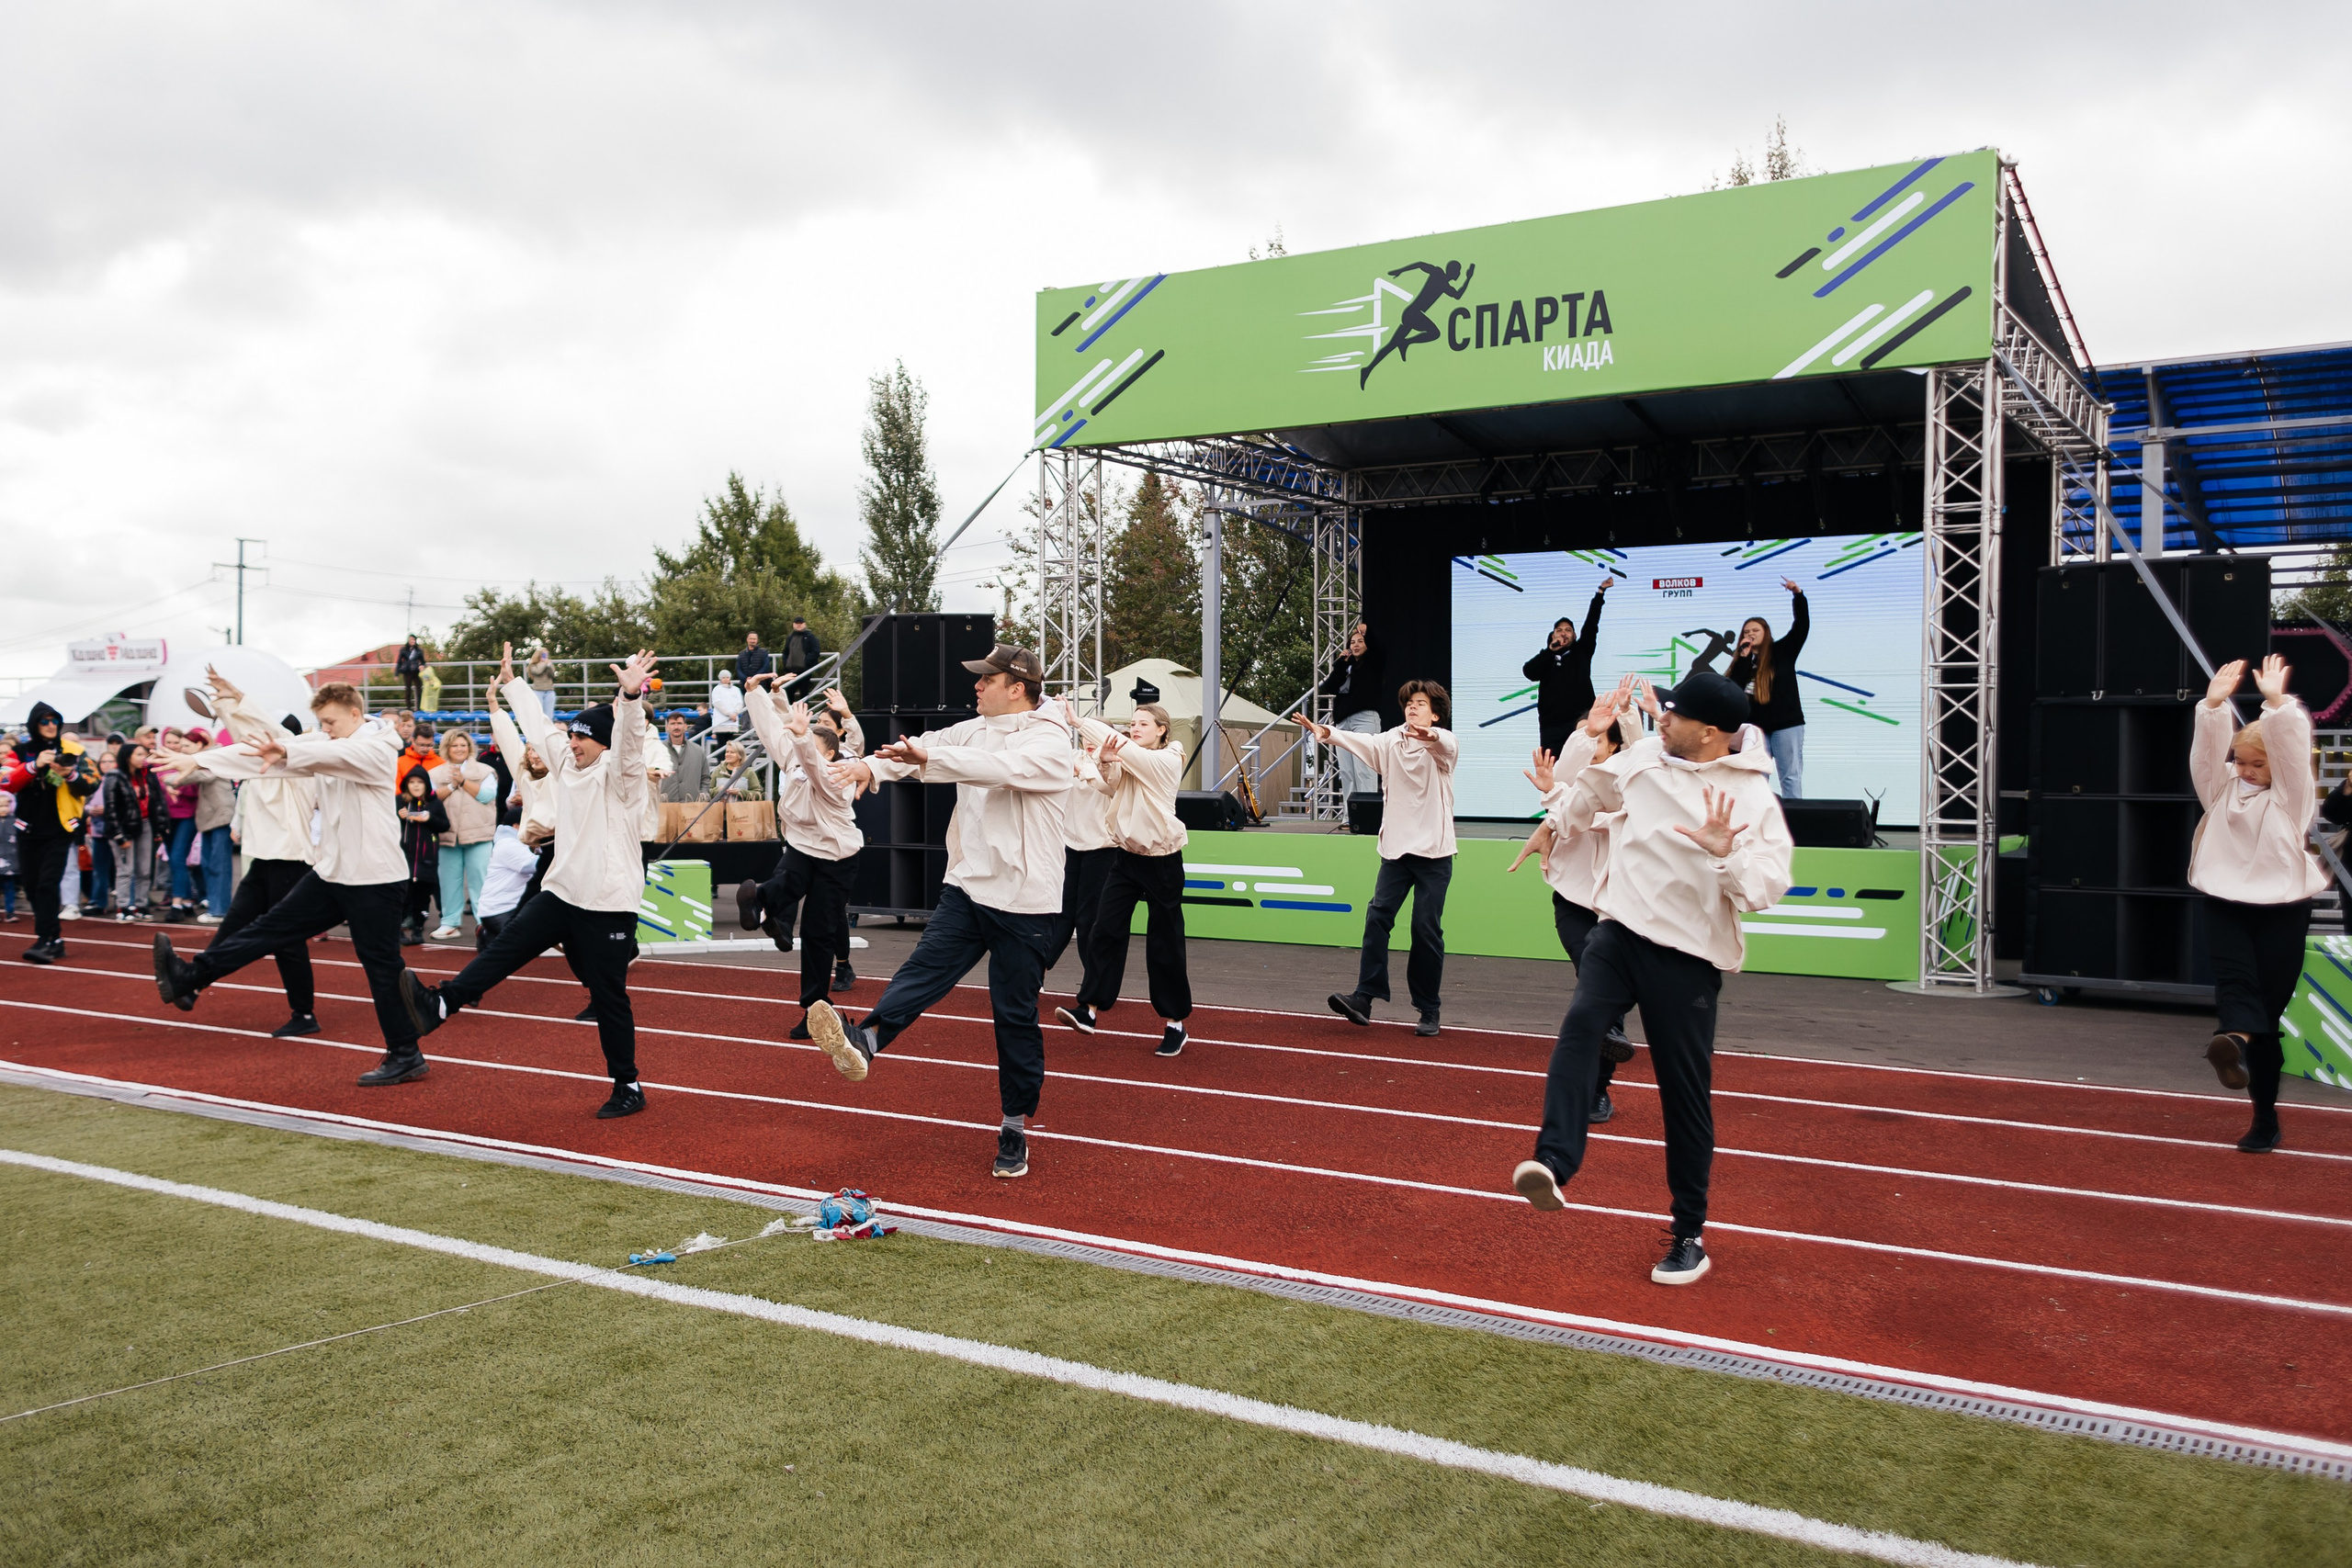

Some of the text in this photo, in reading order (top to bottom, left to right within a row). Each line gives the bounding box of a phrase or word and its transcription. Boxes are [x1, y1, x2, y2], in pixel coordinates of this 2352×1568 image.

[1447, 289, 1613, 352] СПАРТА
[1543, 340, 1614, 371] КИАДА
[1658, 578, 1697, 588] ВОЛКОВ
[1663, 589, 1692, 598] ГРУПП
